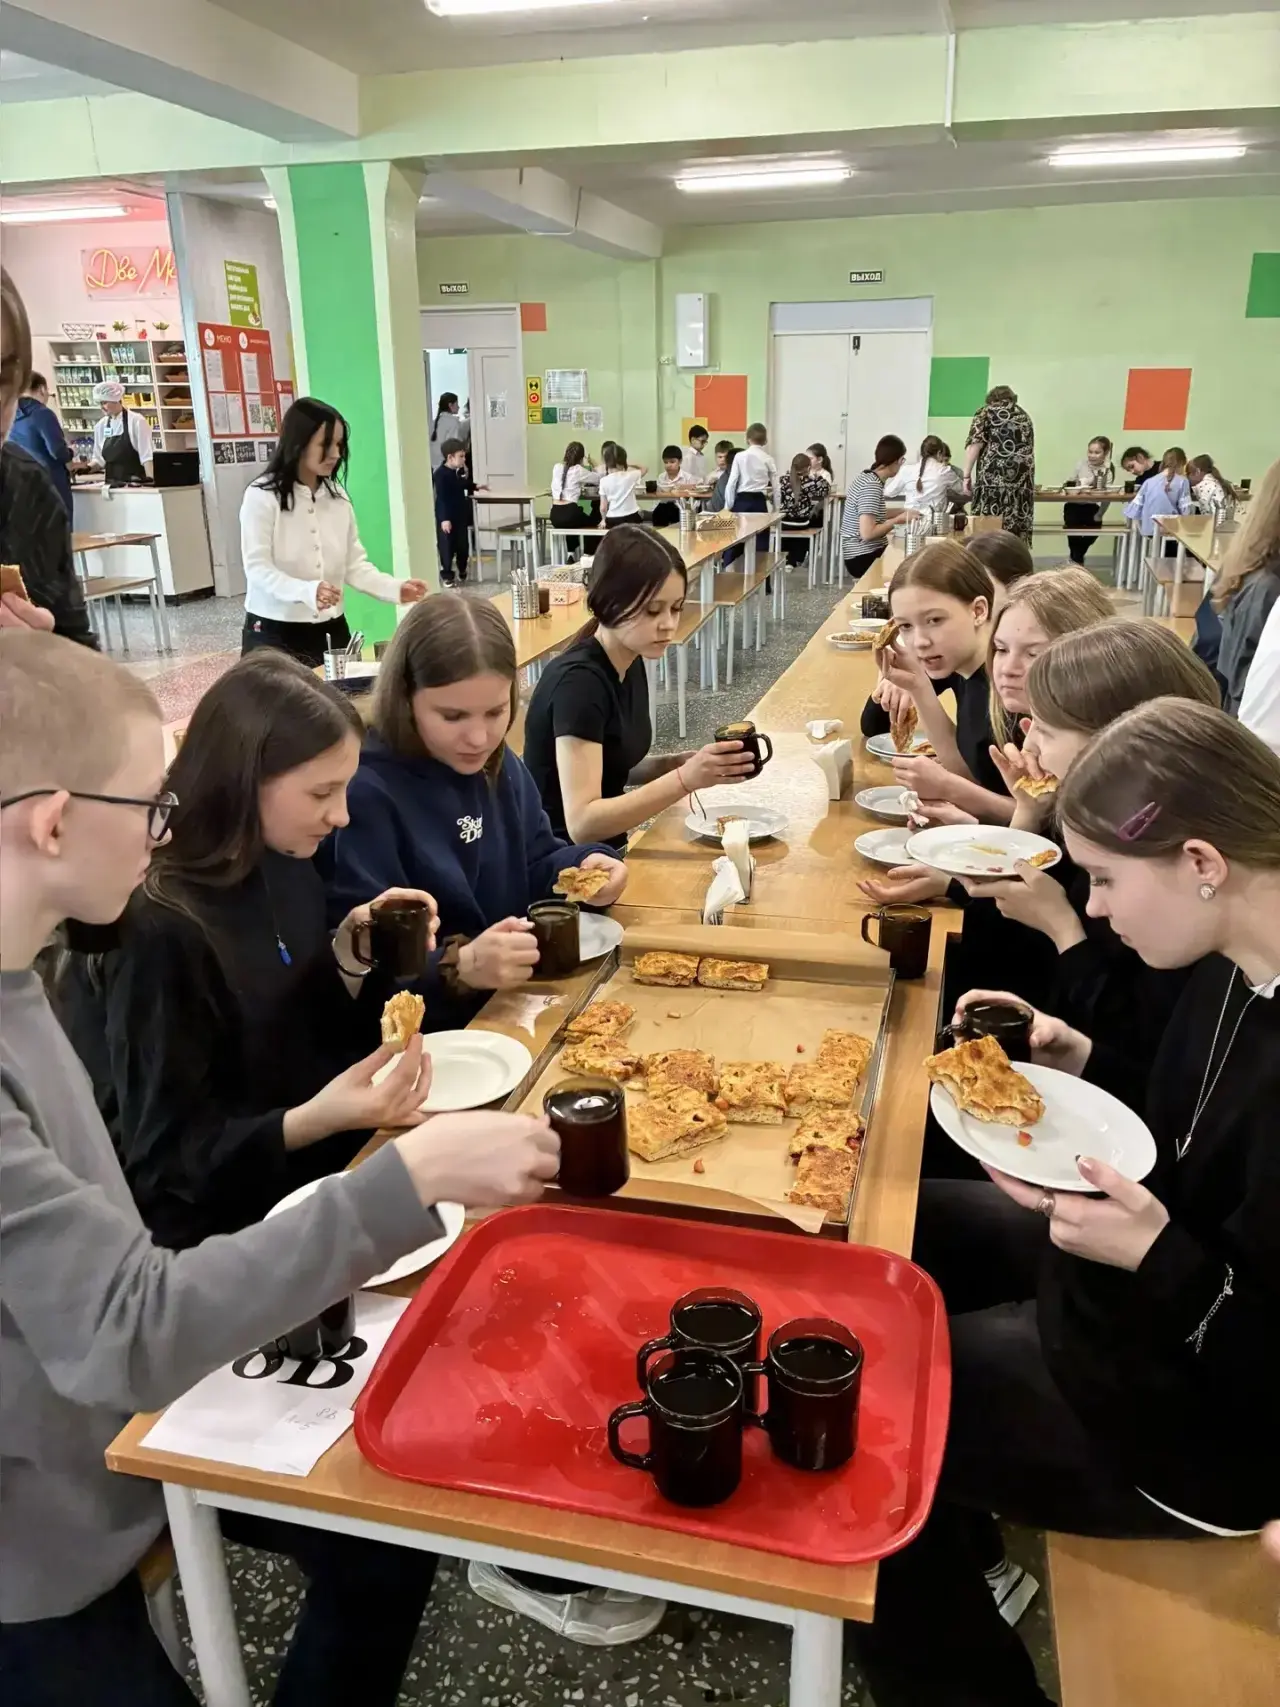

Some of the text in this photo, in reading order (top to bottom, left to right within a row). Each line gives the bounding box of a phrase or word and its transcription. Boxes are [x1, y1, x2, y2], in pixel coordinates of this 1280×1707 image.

[85, 247, 138, 288] Две
[851, 272, 881, 282] ВЫХОД
[440, 284, 468, 293] ВЫХОД
